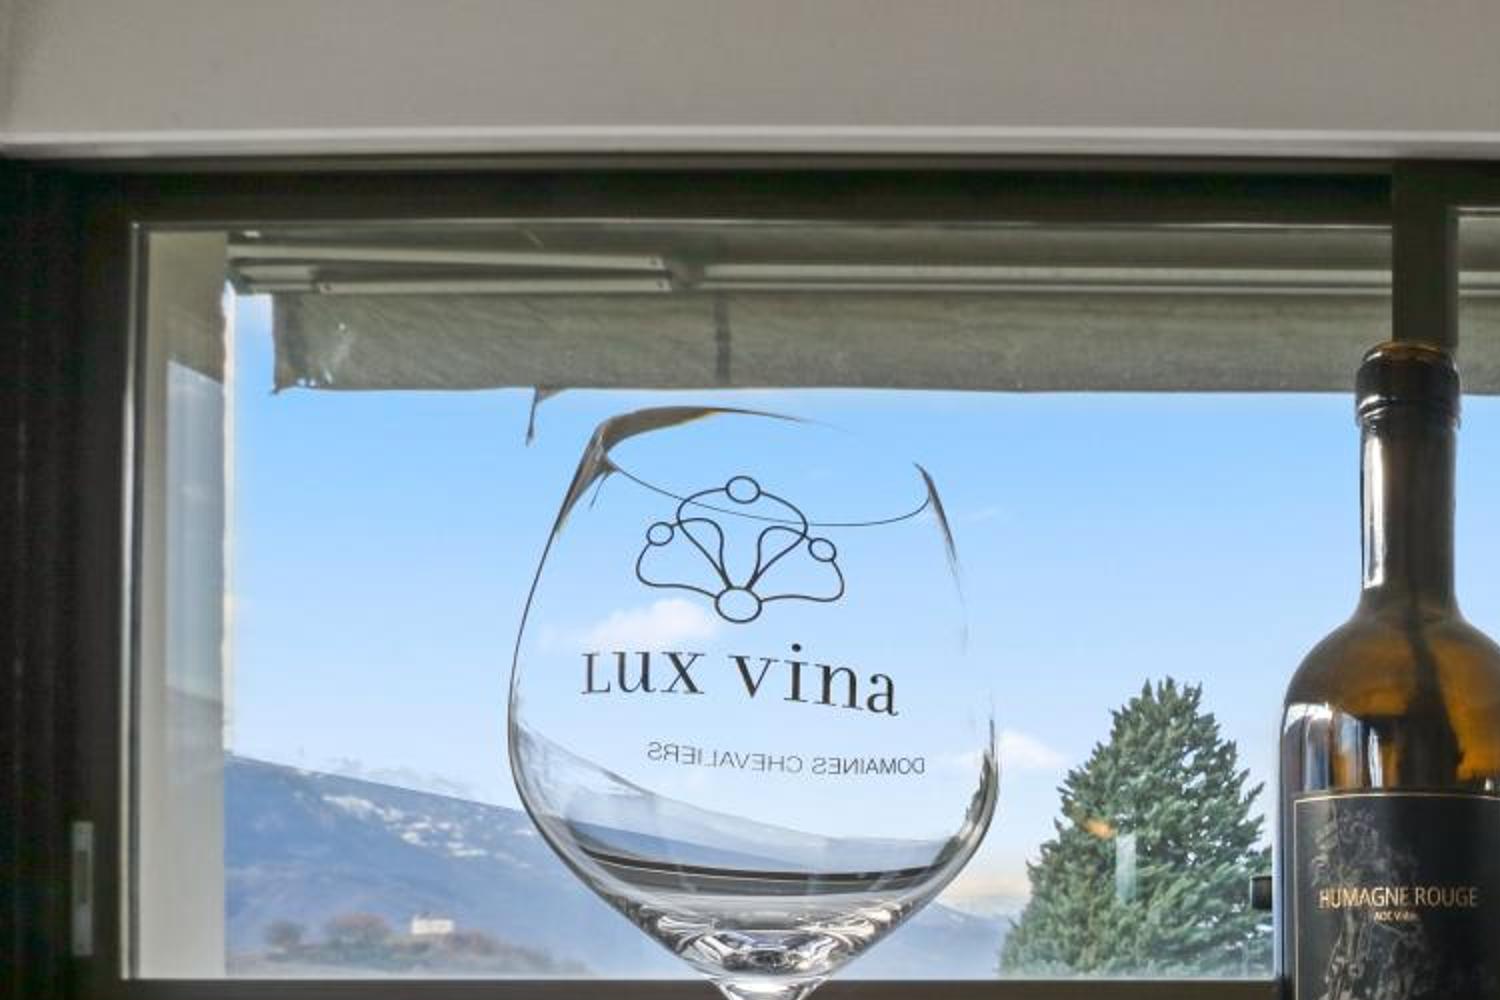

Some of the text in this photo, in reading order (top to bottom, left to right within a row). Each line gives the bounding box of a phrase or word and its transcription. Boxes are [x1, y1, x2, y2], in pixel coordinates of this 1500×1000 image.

[581, 643, 899, 717] Lux vina
[1319, 886, 1480, 909] HUMAGNE ROUGE
